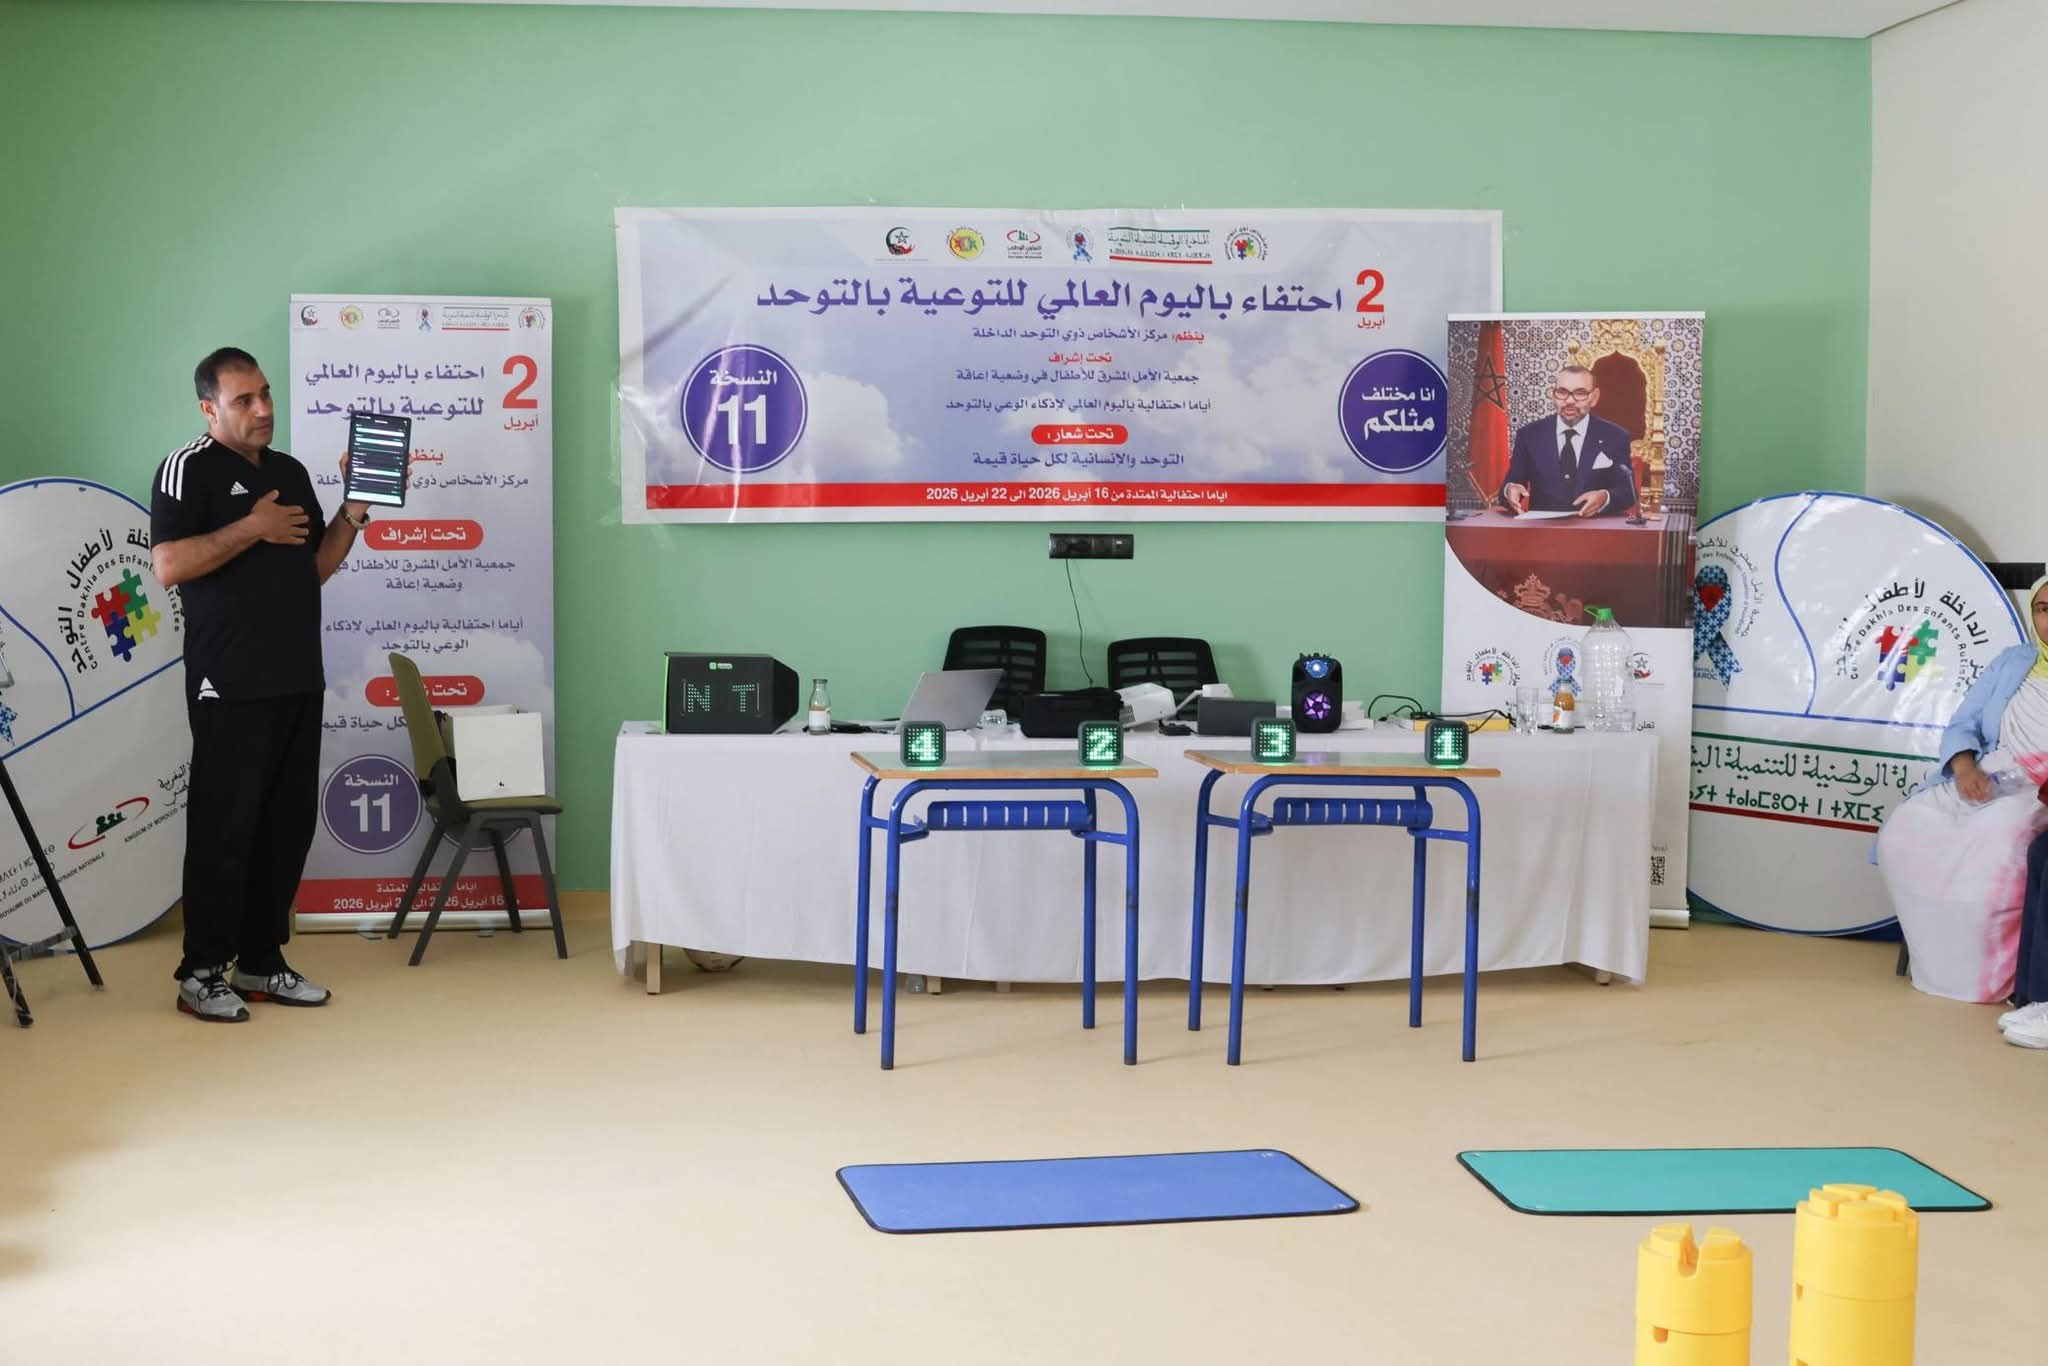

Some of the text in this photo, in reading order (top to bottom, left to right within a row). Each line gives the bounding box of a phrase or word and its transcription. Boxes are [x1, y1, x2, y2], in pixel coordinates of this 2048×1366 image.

[756, 276, 1341, 320] احتفاء باليوم العالمي للتوعية بالتوحد
[1356, 269, 1385, 312] 2
[973, 327, 1016, 338] الداخلة
[1020, 327, 1059, 341] التوحد
[1062, 327, 1084, 341] ذوي
[1143, 328, 1168, 342] مركز
[1048, 352, 1112, 365] تحت إشراف
[305, 362, 485, 386] احتفاء باليوم العالمي
[502, 354, 538, 409] 2
[709, 368, 777, 387] النسخة
[991, 369, 1029, 383] وضعية
[1031, 370, 1048, 383] في
[1097, 369, 1130, 383] المشرق
[1165, 371, 1200, 384] جمعية
[1361, 387, 1416, 401] مختلف
[400, 395, 484, 421] للتوعية
[944, 398, 992, 412] بالتوحد
[994, 398, 1028, 412] الوعي
[1067, 398, 1102, 412] العالمي
[1103, 399, 1136, 412] باليوم
[1137, 399, 1186, 412] احتفالية
[717, 394, 768, 445] 11
[1363, 407, 1435, 440] مثلكم
[1053, 426, 1083, 443] شعار
[1085, 427, 1114, 440] تحت
[972, 452, 1007, 467] قيمة
[1011, 453, 1041, 468] حياة
[1044, 453, 1067, 468] لكل
[1140, 453, 1184, 467] التوحد
[412, 473, 437, 489] ذوي
[499, 473, 529, 489] مركز
[926, 488, 958, 500] 2026
[991, 488, 1008, 499] 22
[1028, 487, 1060, 499] 2026
[1094, 487, 1109, 499] 16
[1110, 490, 1125, 502] من
[1160, 488, 1204, 502] احتفالية
[381, 526, 467, 545] تحت إشراف
[96, 558, 117, 575] Des
[119, 553, 154, 572] Enfant
[402, 558, 439, 574] المشرق
[475, 558, 516, 572] جمعية
[423, 576, 463, 592] وضعية
[57, 528, 114, 674] لأطفال التوحد
[76, 575, 98, 618] Dakhla
[442, 617, 495, 633] احتفالية
[1897, 603, 1919, 614] Des
[1922, 605, 1961, 641] Enfants
[1939, 590, 1989, 645] الداخلة
[365, 618, 401, 635] العالمي
[403, 618, 440, 634] باليوم
[78, 623, 98, 670] Centre
[381, 638, 469, 654] الوعي بالتوحد
[431, 681, 468, 697] تحت
[350, 715, 383, 732] حياة
[911, 731, 938, 761] 4
[1088, 731, 1114, 761] 2
[1261, 727, 1287, 757] 3
[1436, 730, 1463, 760] 1
[1724, 745, 1797, 781] للتنمية
[343, 773, 400, 787] النسخة
[1801, 754, 1888, 797] الوطنية
[349, 793, 391, 833] 11
[333, 898, 364, 910] 2026
